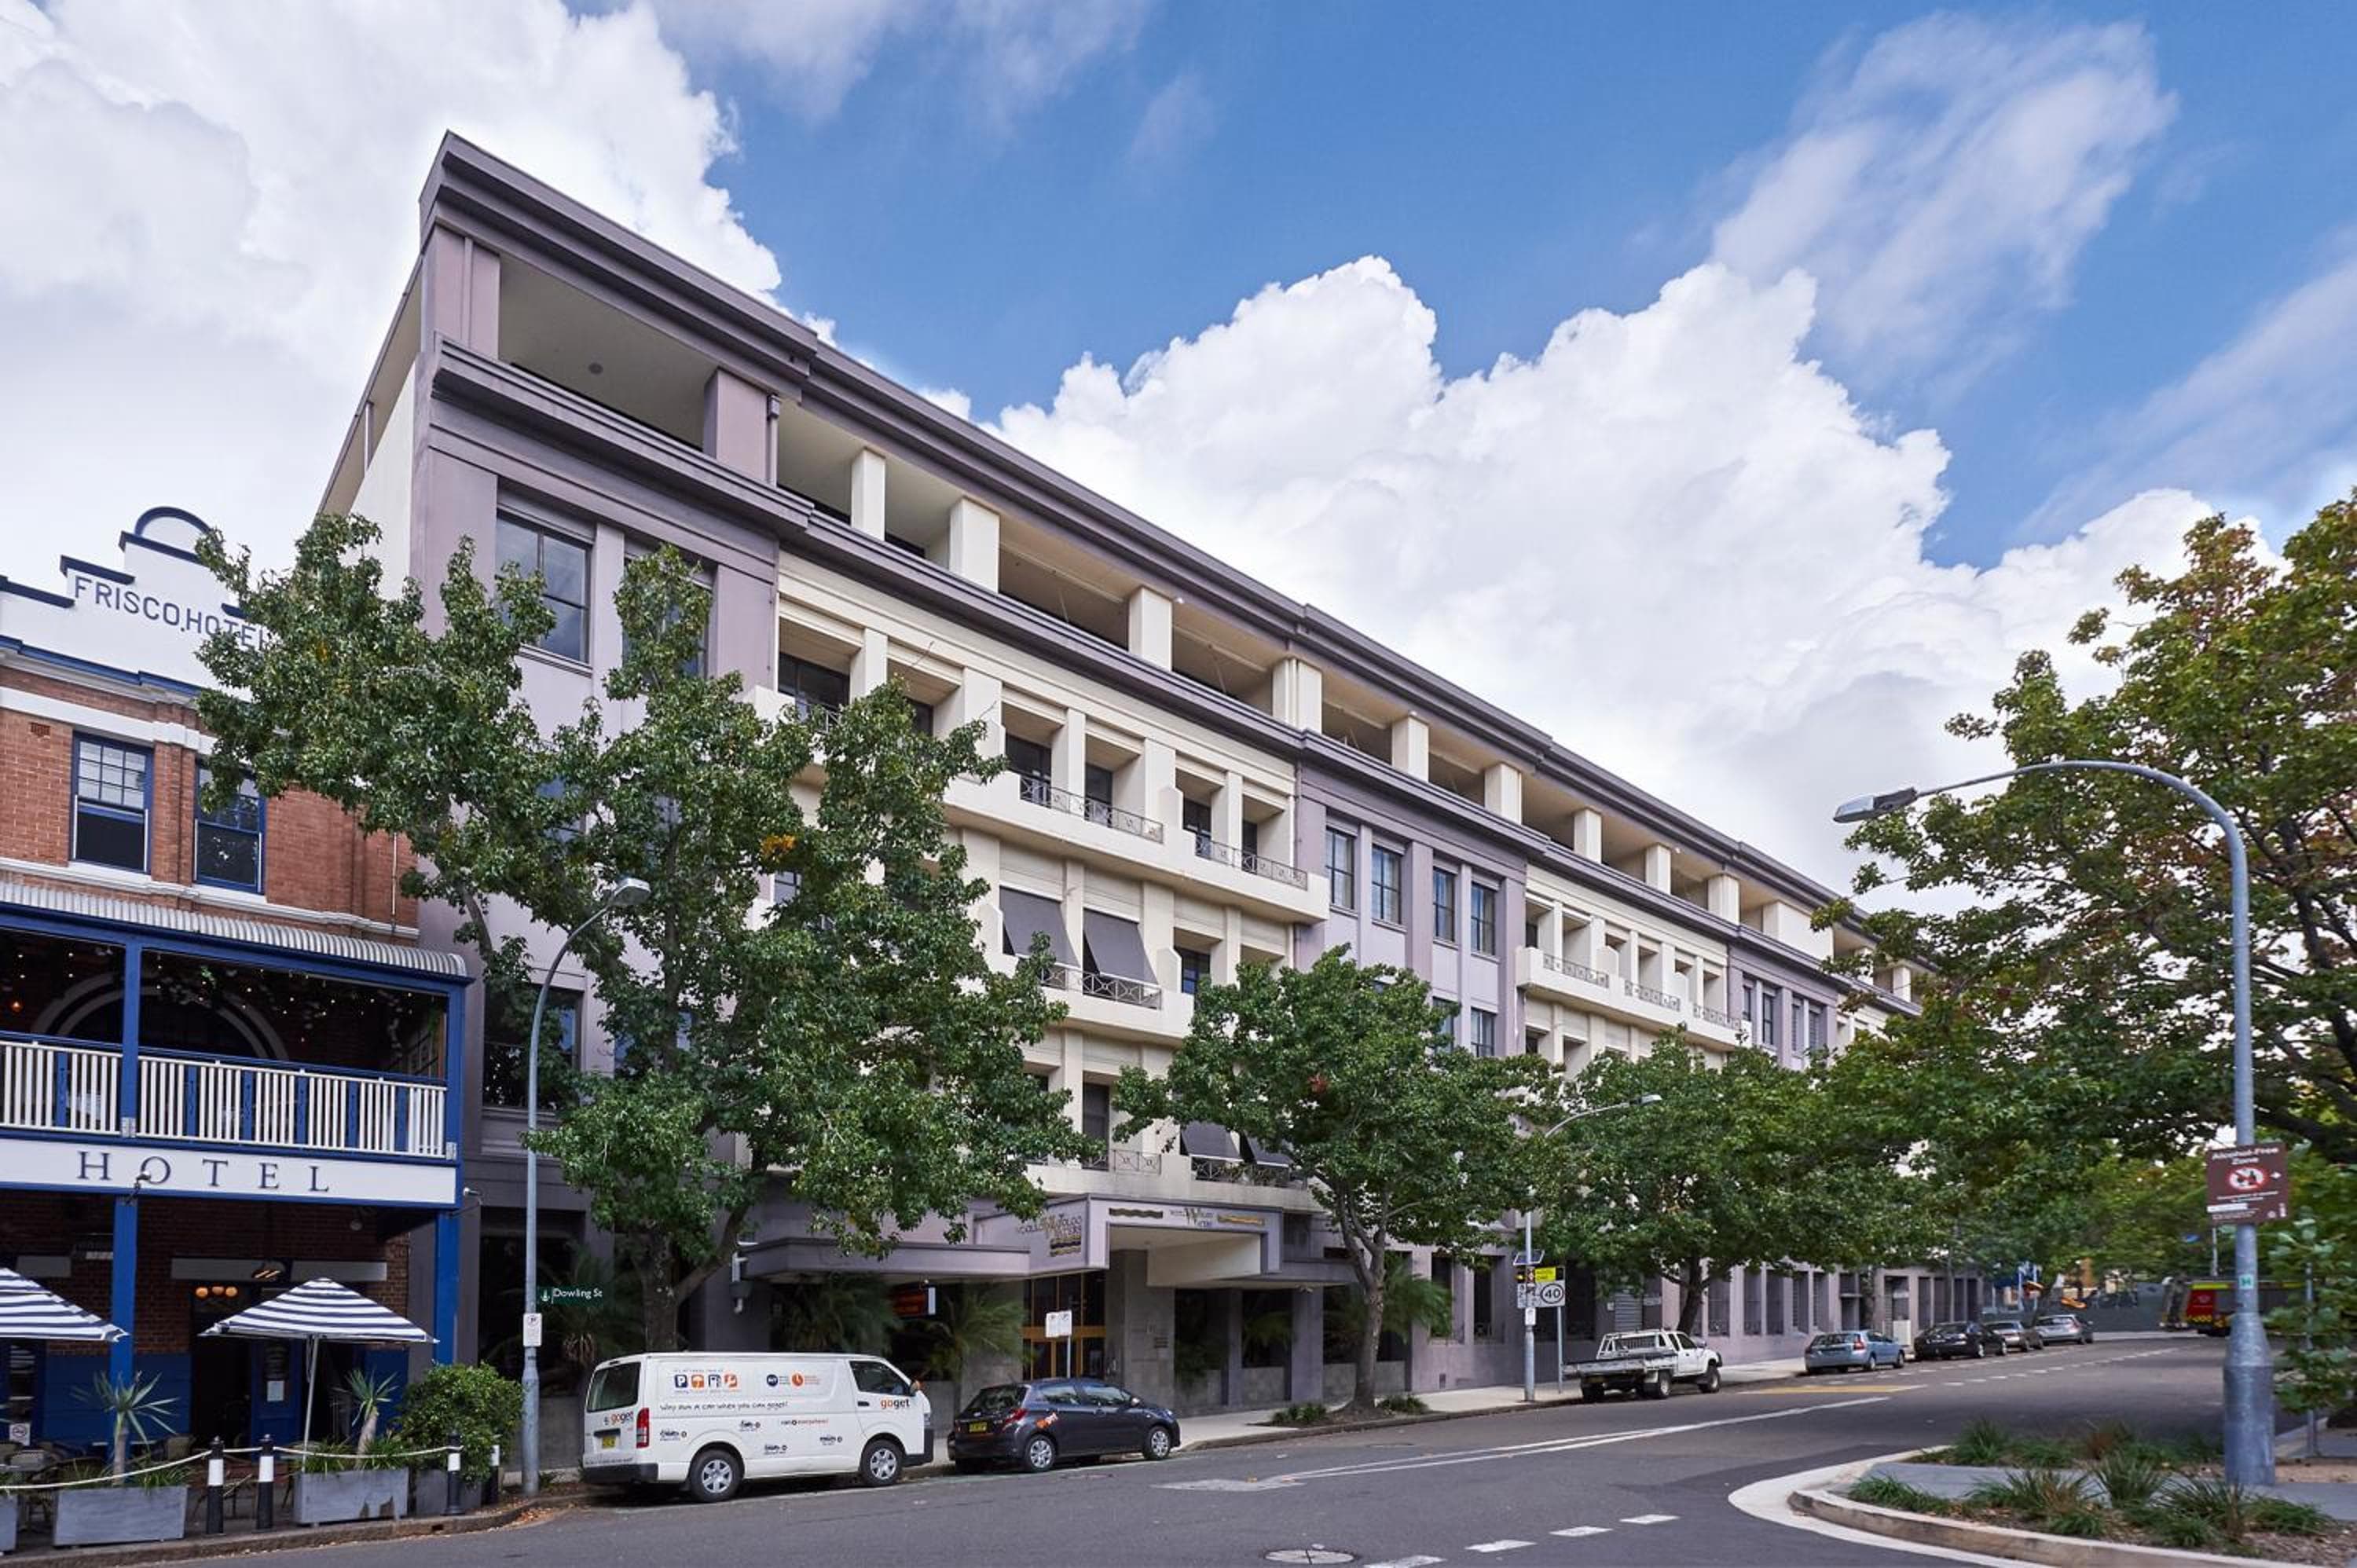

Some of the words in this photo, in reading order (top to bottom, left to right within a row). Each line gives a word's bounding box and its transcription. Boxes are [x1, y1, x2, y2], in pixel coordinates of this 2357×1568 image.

[77, 1151, 330, 1192] HOTEL
[552, 1288, 592, 1299] Dowling
[593, 1288, 603, 1297] St
[1545, 1288, 1561, 1299] 40
[879, 1398, 911, 1410] goget
[610, 1411, 634, 1425] goget
